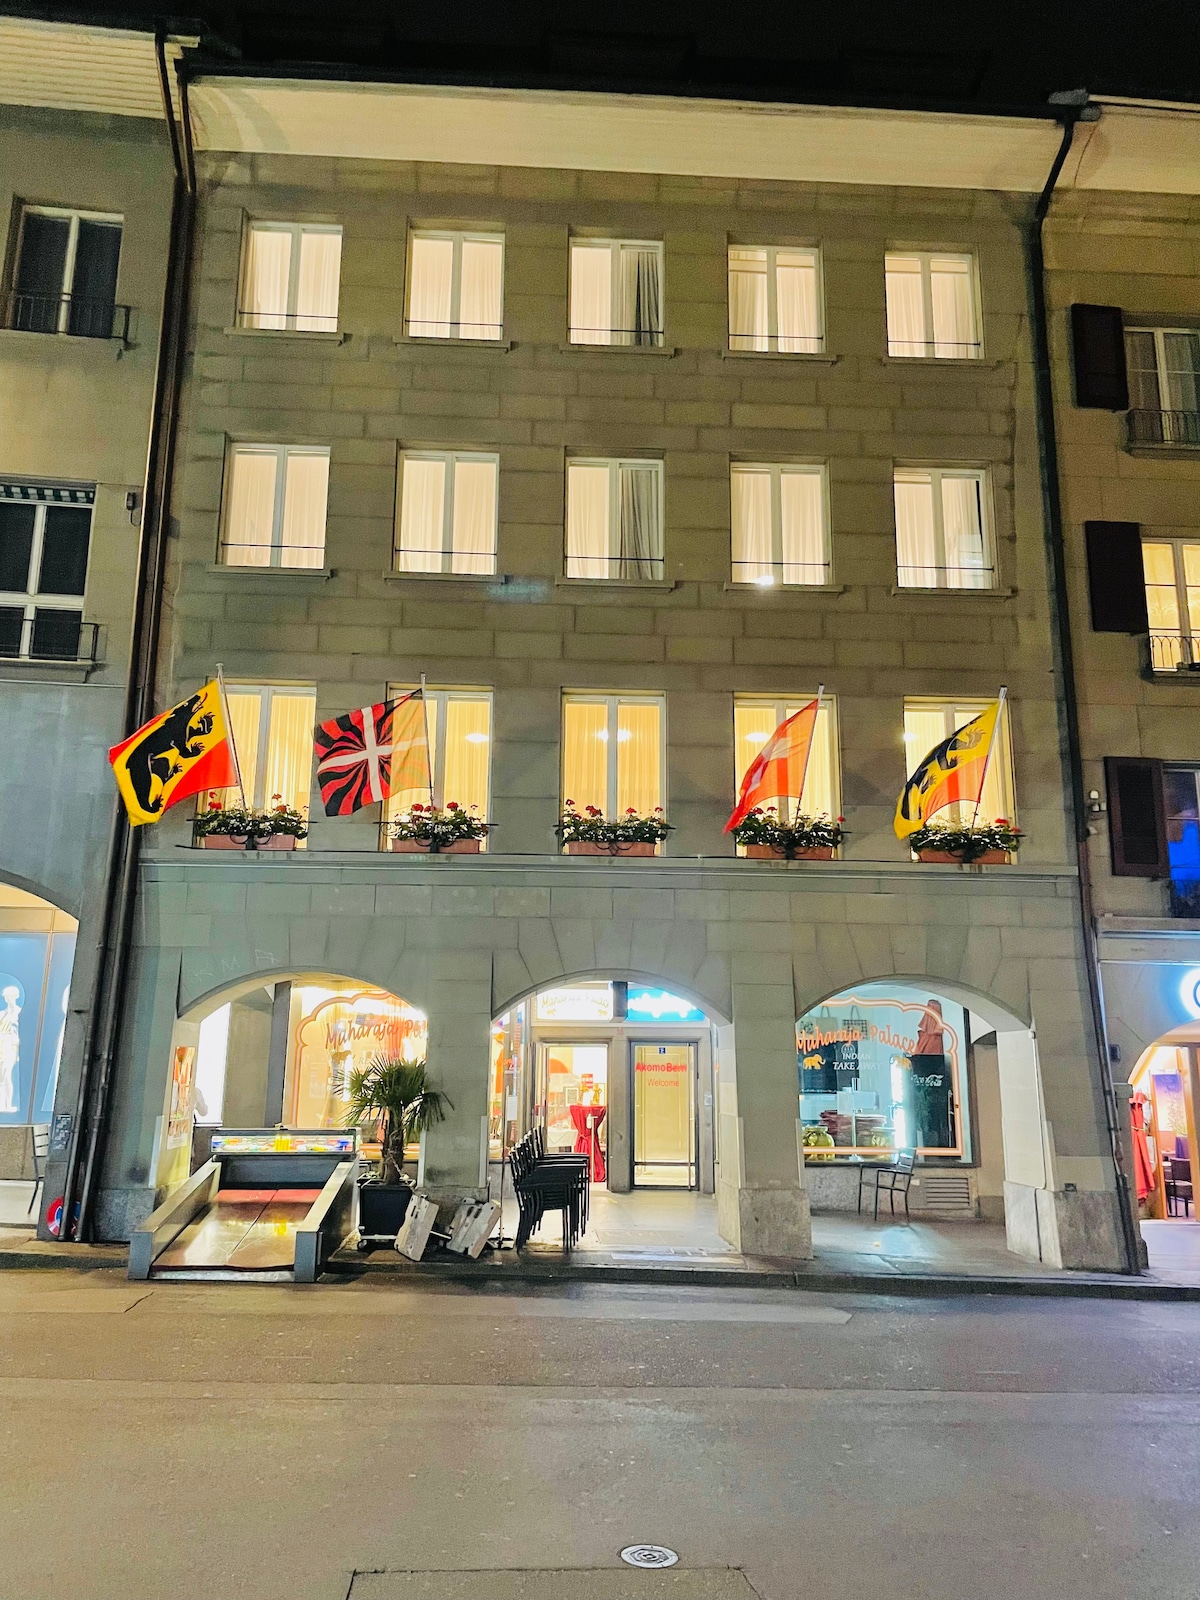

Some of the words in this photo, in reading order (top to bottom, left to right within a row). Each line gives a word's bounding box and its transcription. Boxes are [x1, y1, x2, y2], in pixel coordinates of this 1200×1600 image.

[325, 1019, 398, 1050] Maharaja
[796, 1025, 863, 1056] Maharaja
[869, 1024, 917, 1055] Palace
[842, 1052, 872, 1060] INDIAN
[833, 1061, 855, 1070] TAKE
[857, 1061, 881, 1070] AWAY
[647, 1079, 680, 1087] Welcome
